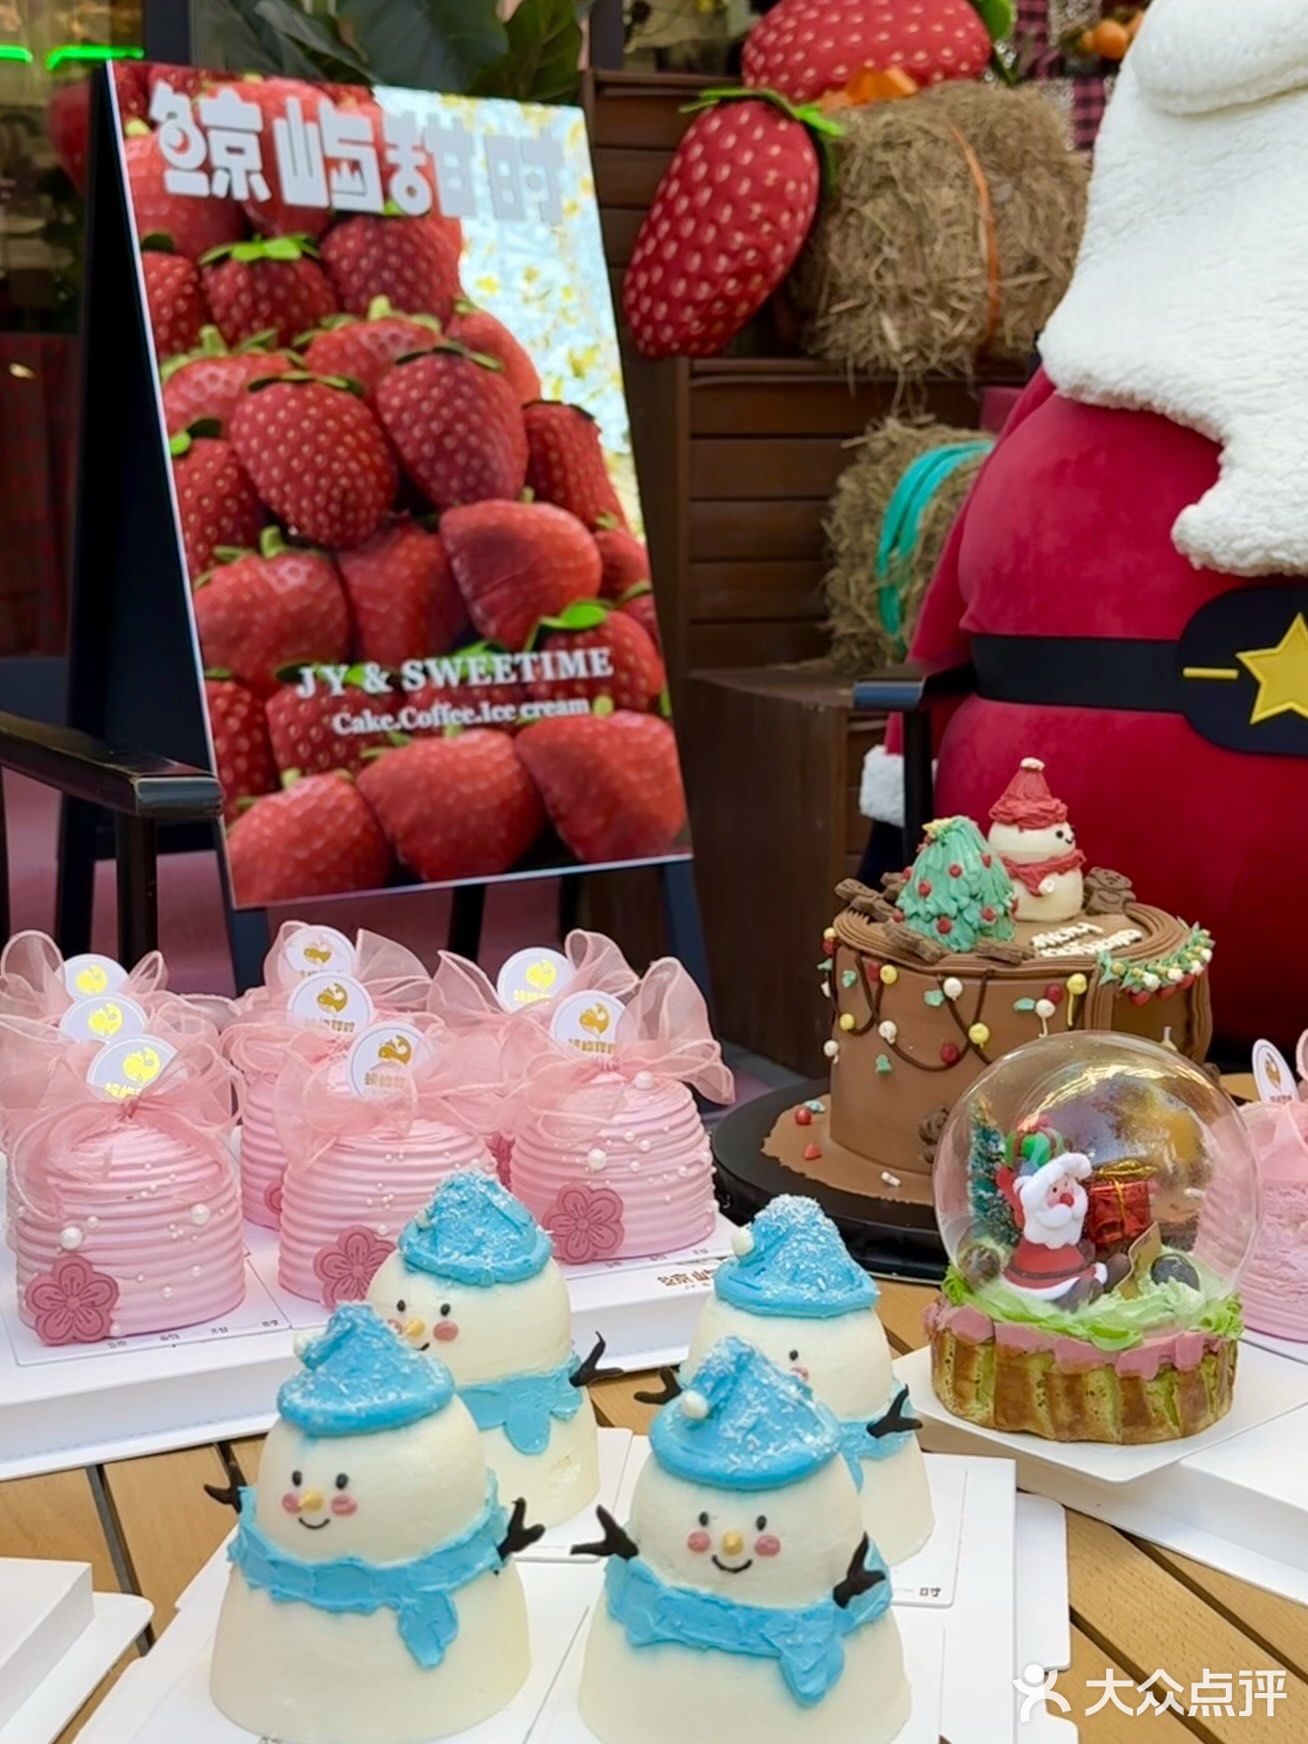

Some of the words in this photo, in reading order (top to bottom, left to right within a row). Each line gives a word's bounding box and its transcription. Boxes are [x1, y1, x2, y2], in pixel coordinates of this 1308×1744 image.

[296, 663, 349, 698] JY
[362, 661, 393, 693] &
[401, 646, 614, 691] SWEETIME
[519, 697, 590, 718] cream
